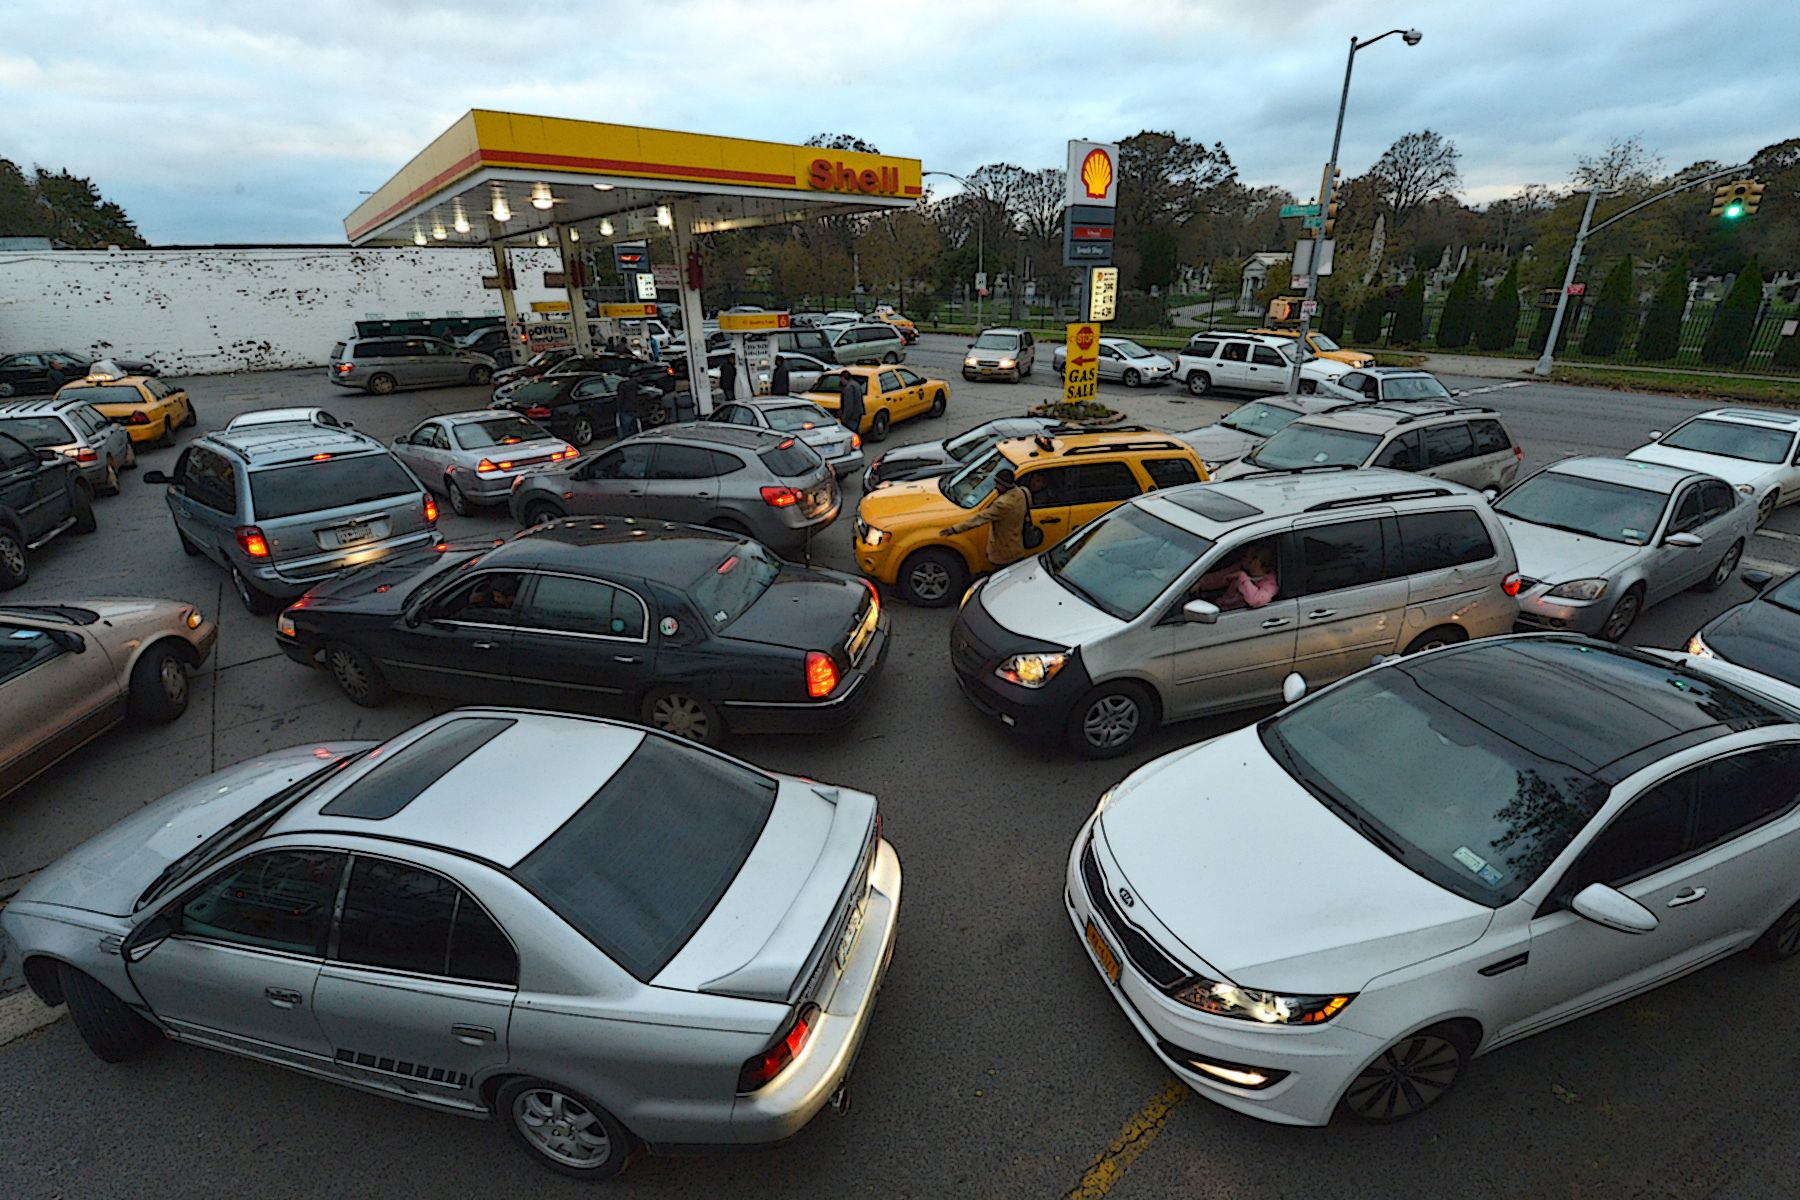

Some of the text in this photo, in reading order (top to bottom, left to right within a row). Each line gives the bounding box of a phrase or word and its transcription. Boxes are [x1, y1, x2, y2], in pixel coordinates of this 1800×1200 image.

[808, 158, 899, 195] Shell
[646, 305, 652, 314] 4
[780, 316, 787, 327] 6
[1077, 333, 1093, 344] STOP
[1068, 368, 1095, 383] GAS
[1066, 383, 1095, 399] SALE
